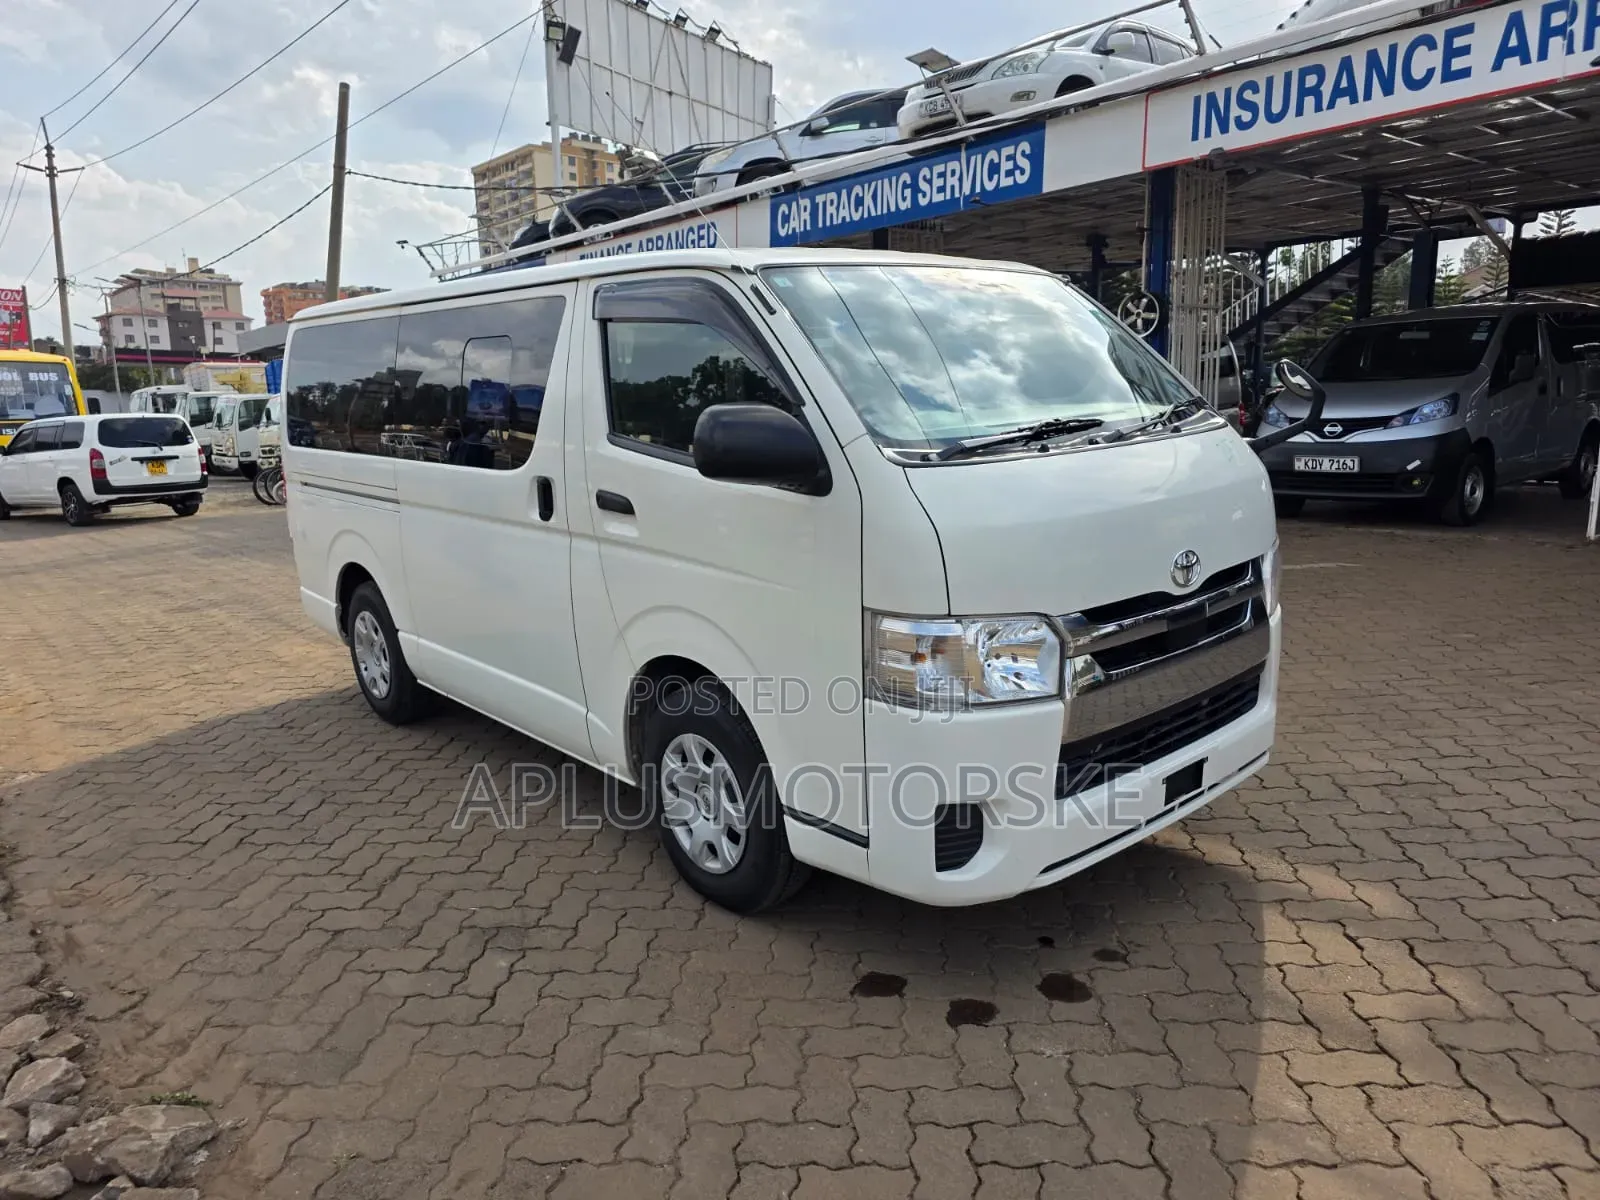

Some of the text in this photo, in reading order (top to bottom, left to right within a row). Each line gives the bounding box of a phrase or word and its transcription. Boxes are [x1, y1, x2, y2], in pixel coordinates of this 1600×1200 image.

[1190, 22, 1476, 142] INSURANCE
[777, 141, 1031, 237] CAR TRACKING SERVICES
[0, 290, 23, 301] ON
[0, 371, 59, 381] OL BUS
[1328, 459, 1356, 471] 716J
